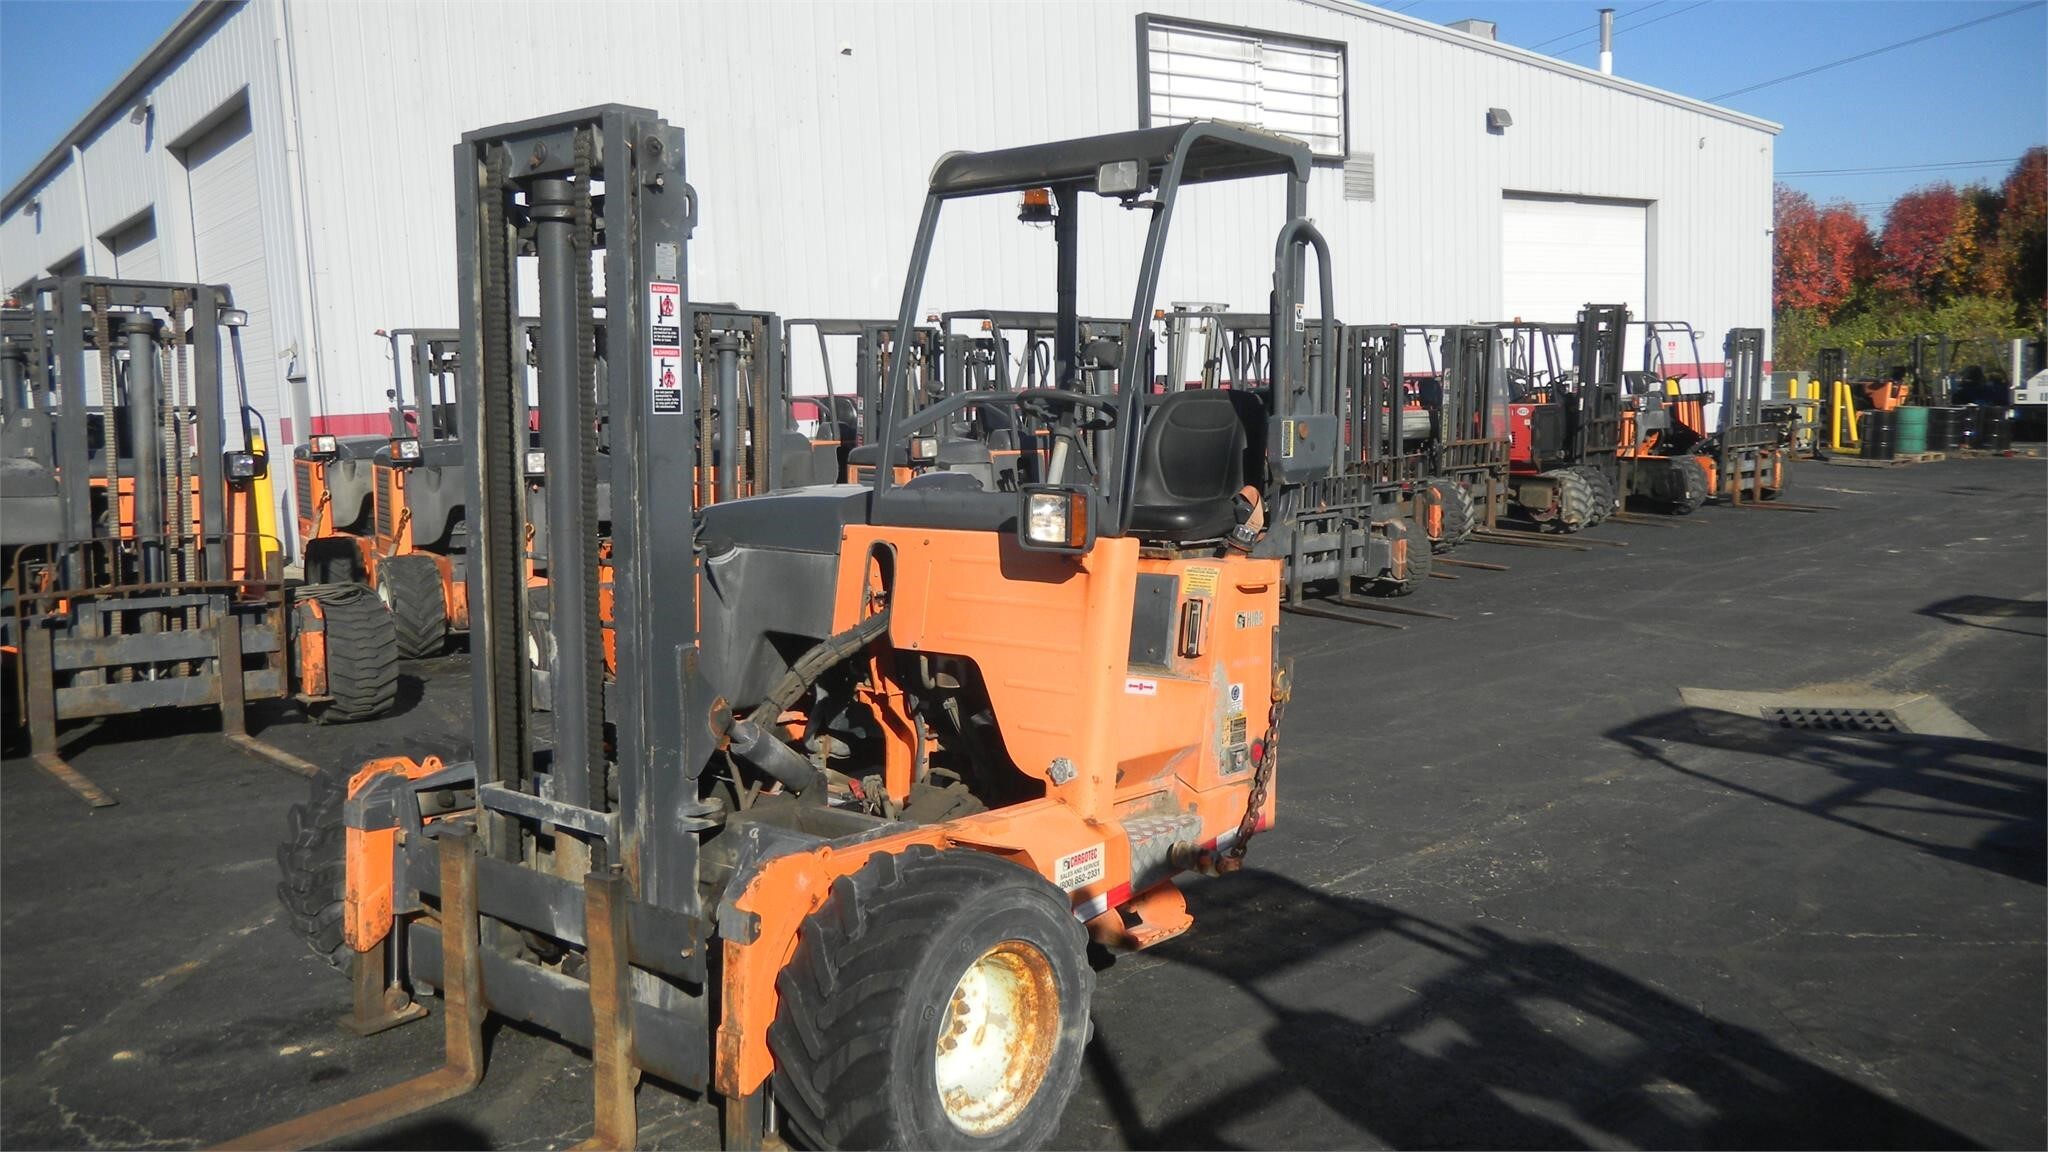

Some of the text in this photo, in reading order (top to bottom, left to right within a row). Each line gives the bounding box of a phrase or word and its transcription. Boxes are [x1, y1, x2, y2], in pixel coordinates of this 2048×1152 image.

[1071, 848, 1097, 867] CARGOTEC
[1060, 870, 1073, 880] SALES
[1083, 861, 1099, 871] SERVICE
[1074, 868, 1100, 884] 852-2331
